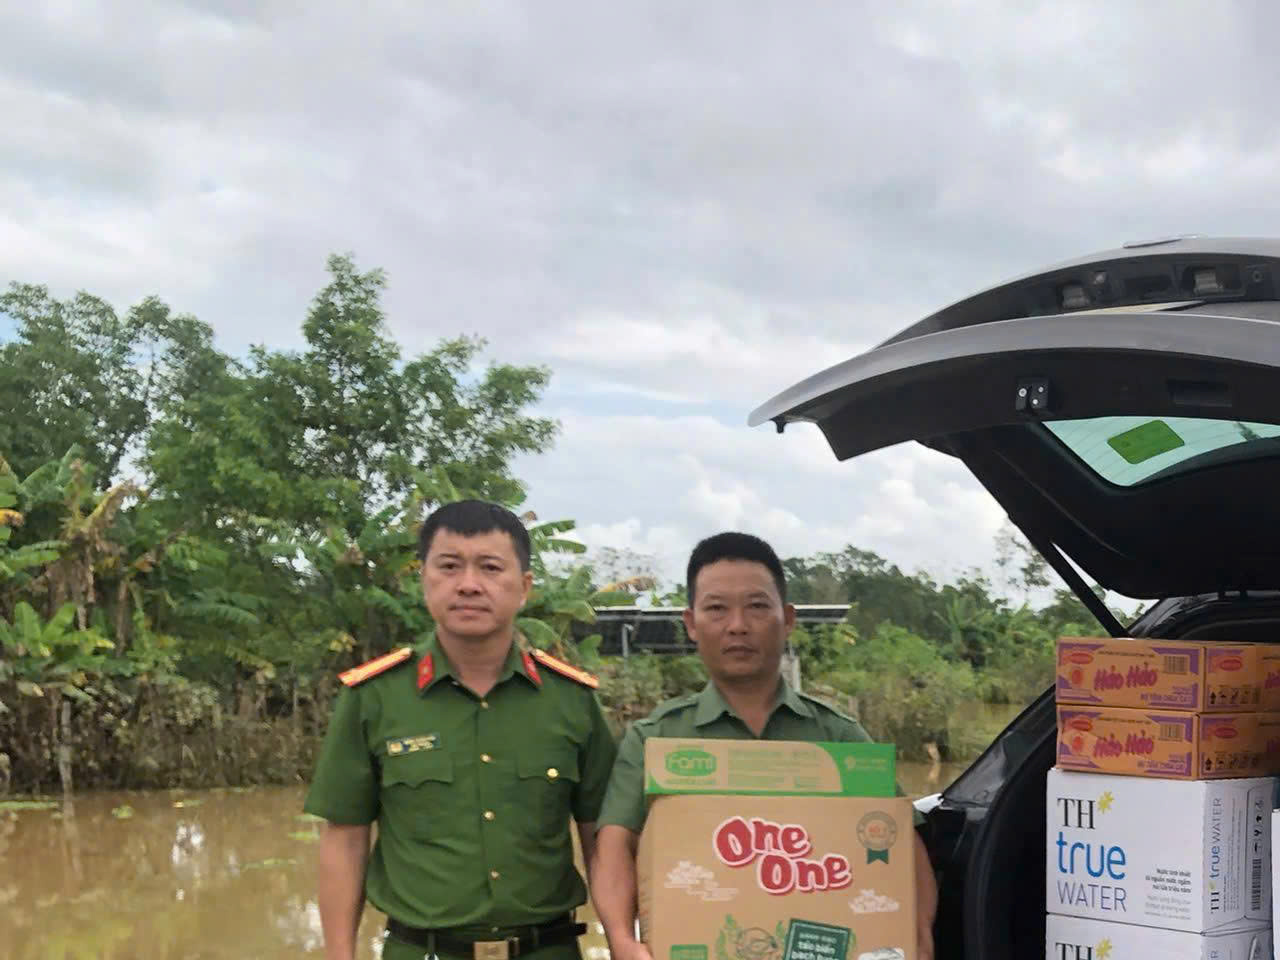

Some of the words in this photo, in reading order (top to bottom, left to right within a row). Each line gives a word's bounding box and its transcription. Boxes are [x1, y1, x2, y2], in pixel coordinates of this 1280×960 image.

[1057, 798, 1096, 829] TH
[713, 816, 811, 867] One
[1056, 831, 1126, 880] true
[758, 853, 852, 894] One
[1057, 881, 1127, 912] WATER
